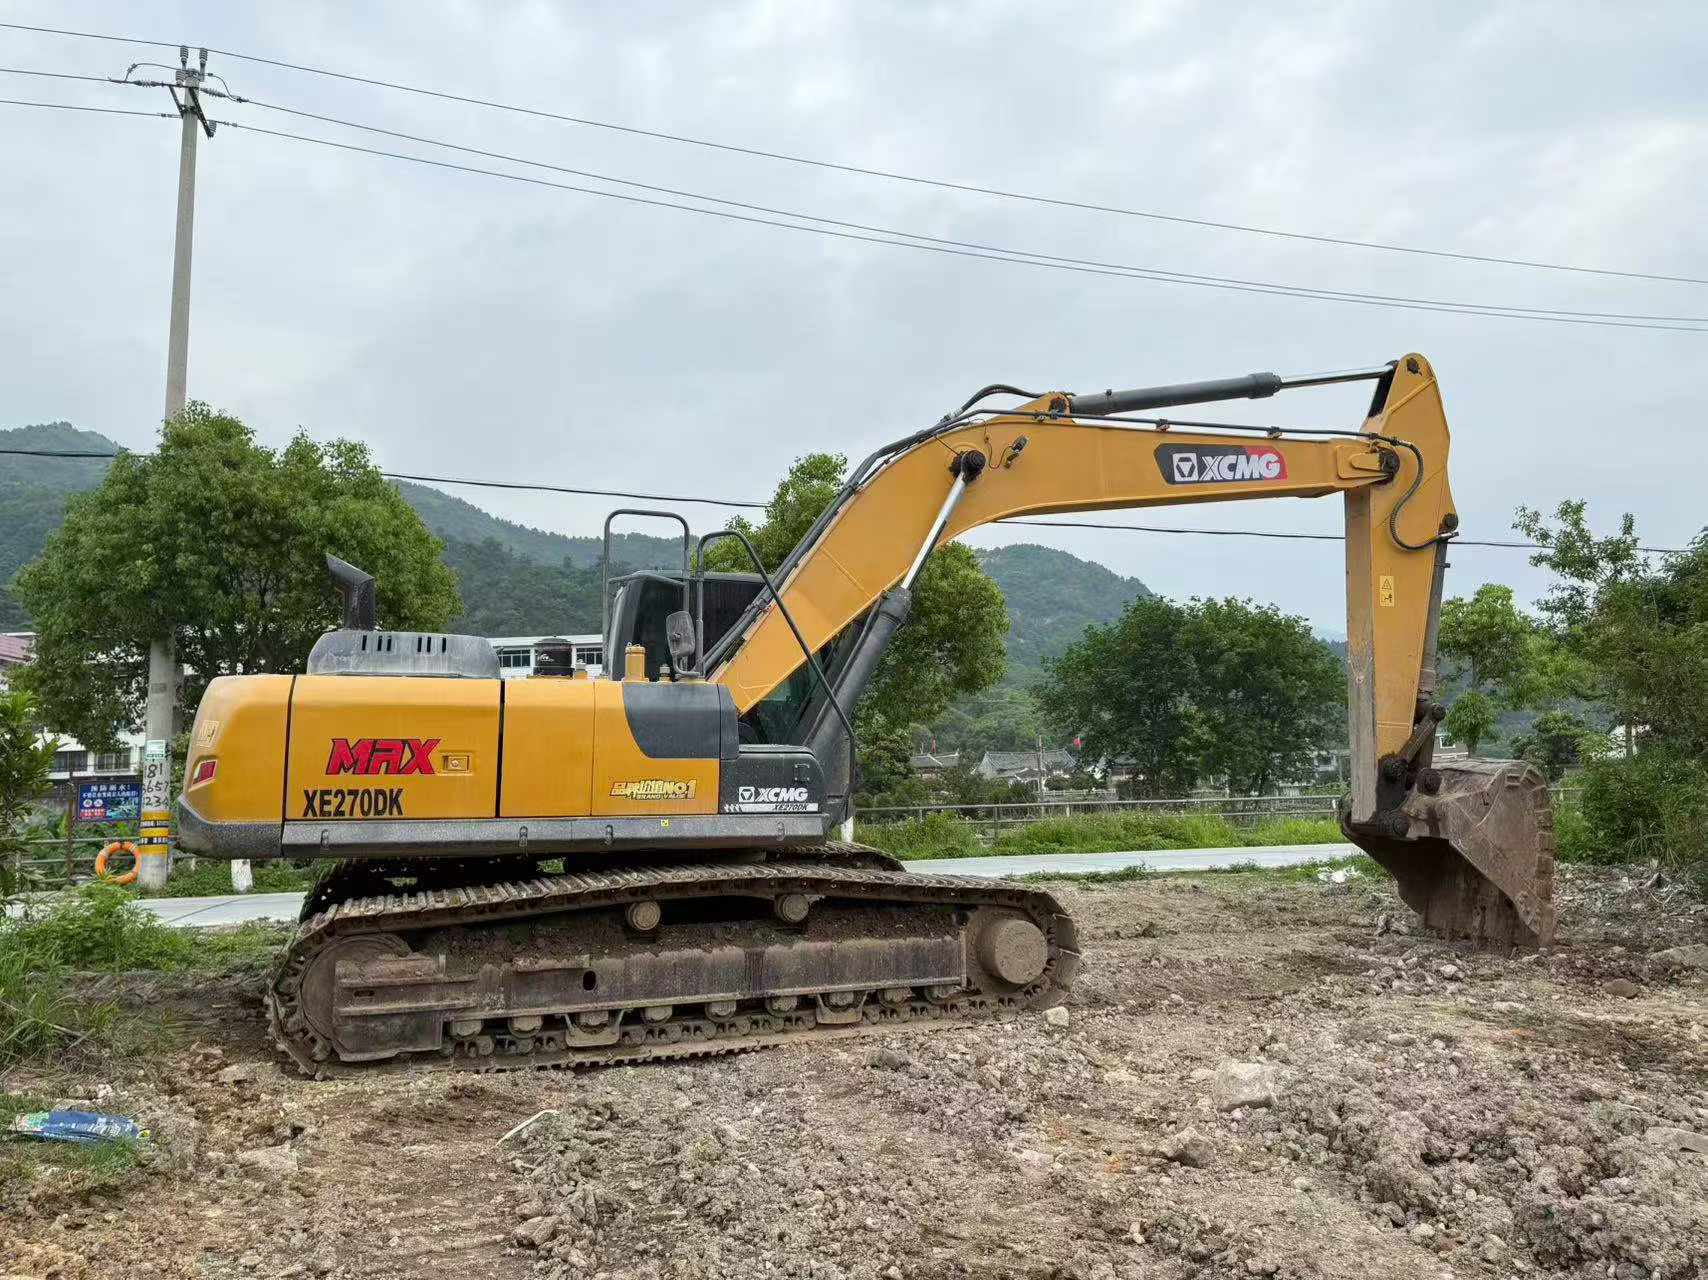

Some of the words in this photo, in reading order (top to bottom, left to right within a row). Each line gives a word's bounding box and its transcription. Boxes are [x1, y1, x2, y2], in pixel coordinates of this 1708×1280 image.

[1200, 453, 1281, 481] XCMG
[326, 738, 442, 775] MAX
[302, 788, 404, 818] XE270DK
[755, 787, 809, 802] XCMG
